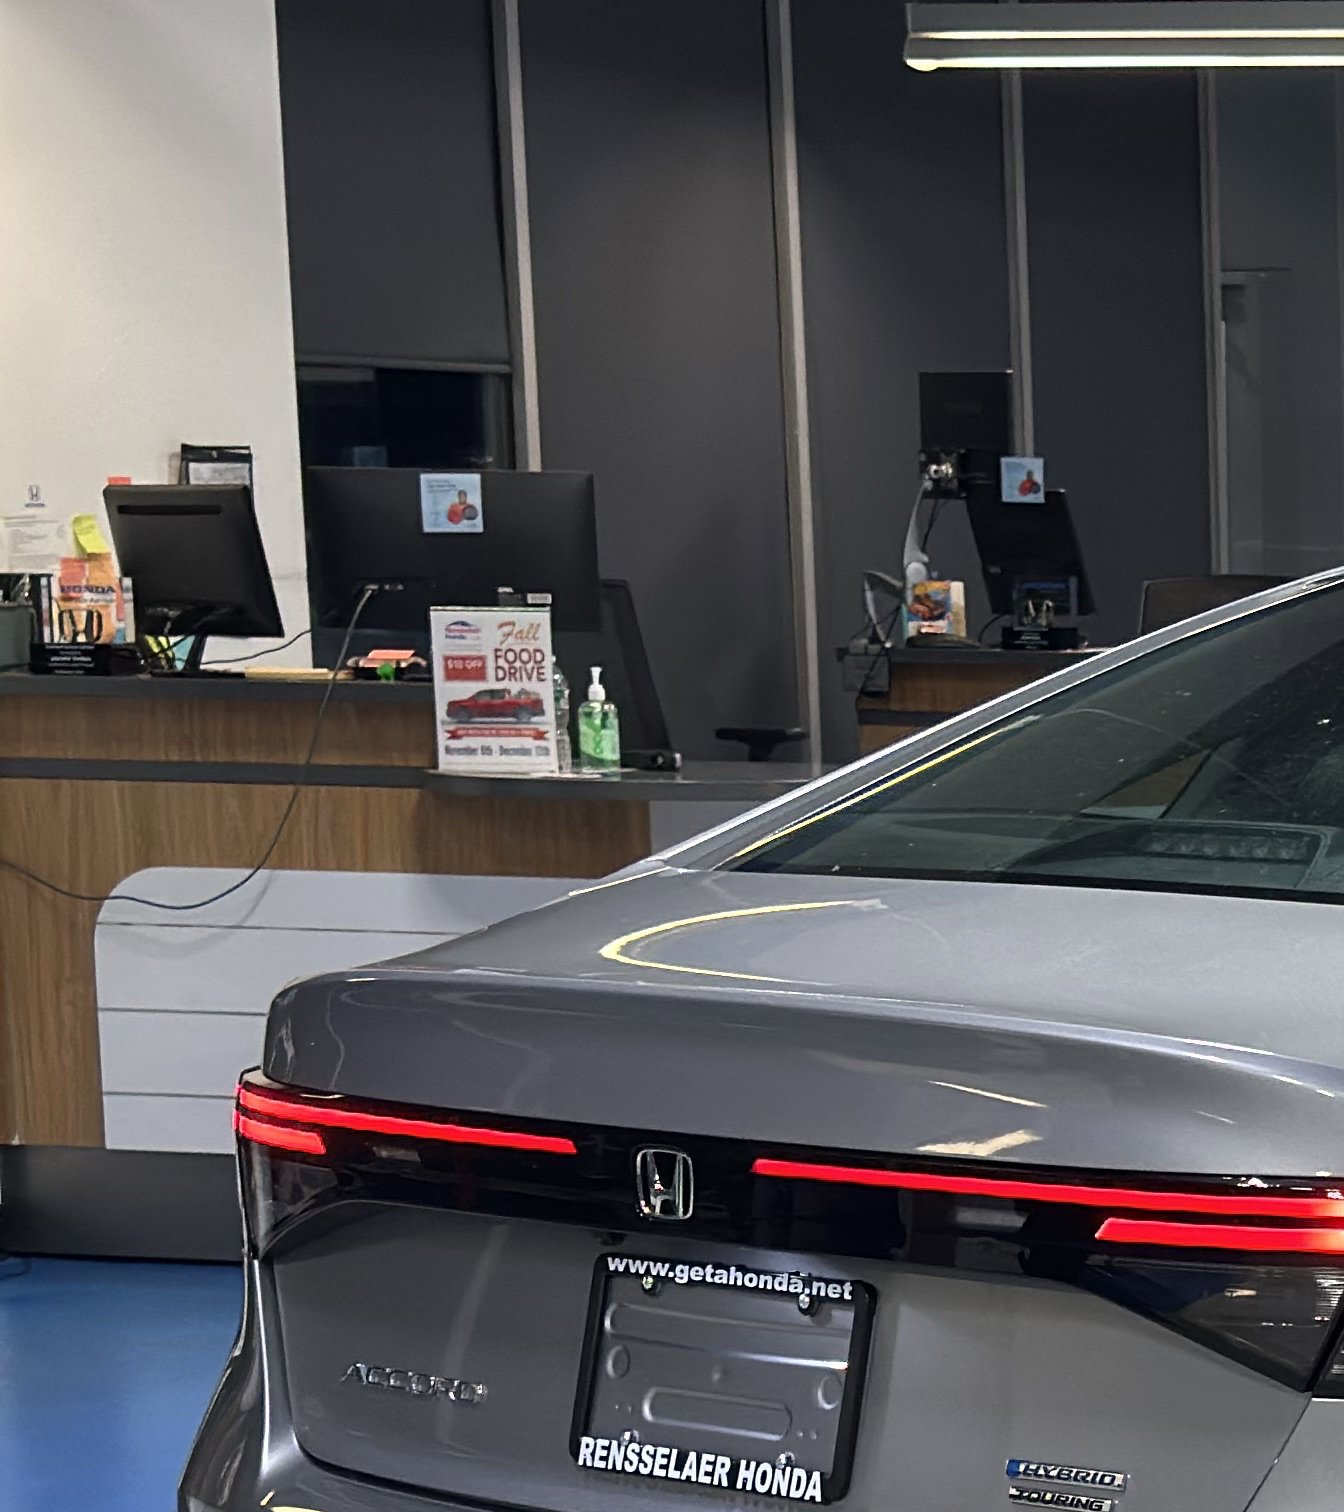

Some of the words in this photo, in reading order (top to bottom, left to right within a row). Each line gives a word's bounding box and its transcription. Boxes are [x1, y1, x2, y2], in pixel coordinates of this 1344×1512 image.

[60, 585, 116, 595] HONDA
[497, 620, 541, 645] Fall
[494, 648, 545, 665] FOOD
[495, 666, 547, 682] DRIVE
[607, 1256, 853, 1300] www.getahonda.net
[340, 1363, 488, 1402] ACCORD
[578, 1436, 731, 1487] RENSSELAER
[736, 1459, 822, 1502] HONDA
[1021, 1463, 1117, 1486] HYBRID
[1015, 1489, 1106, 1512] TOURING
